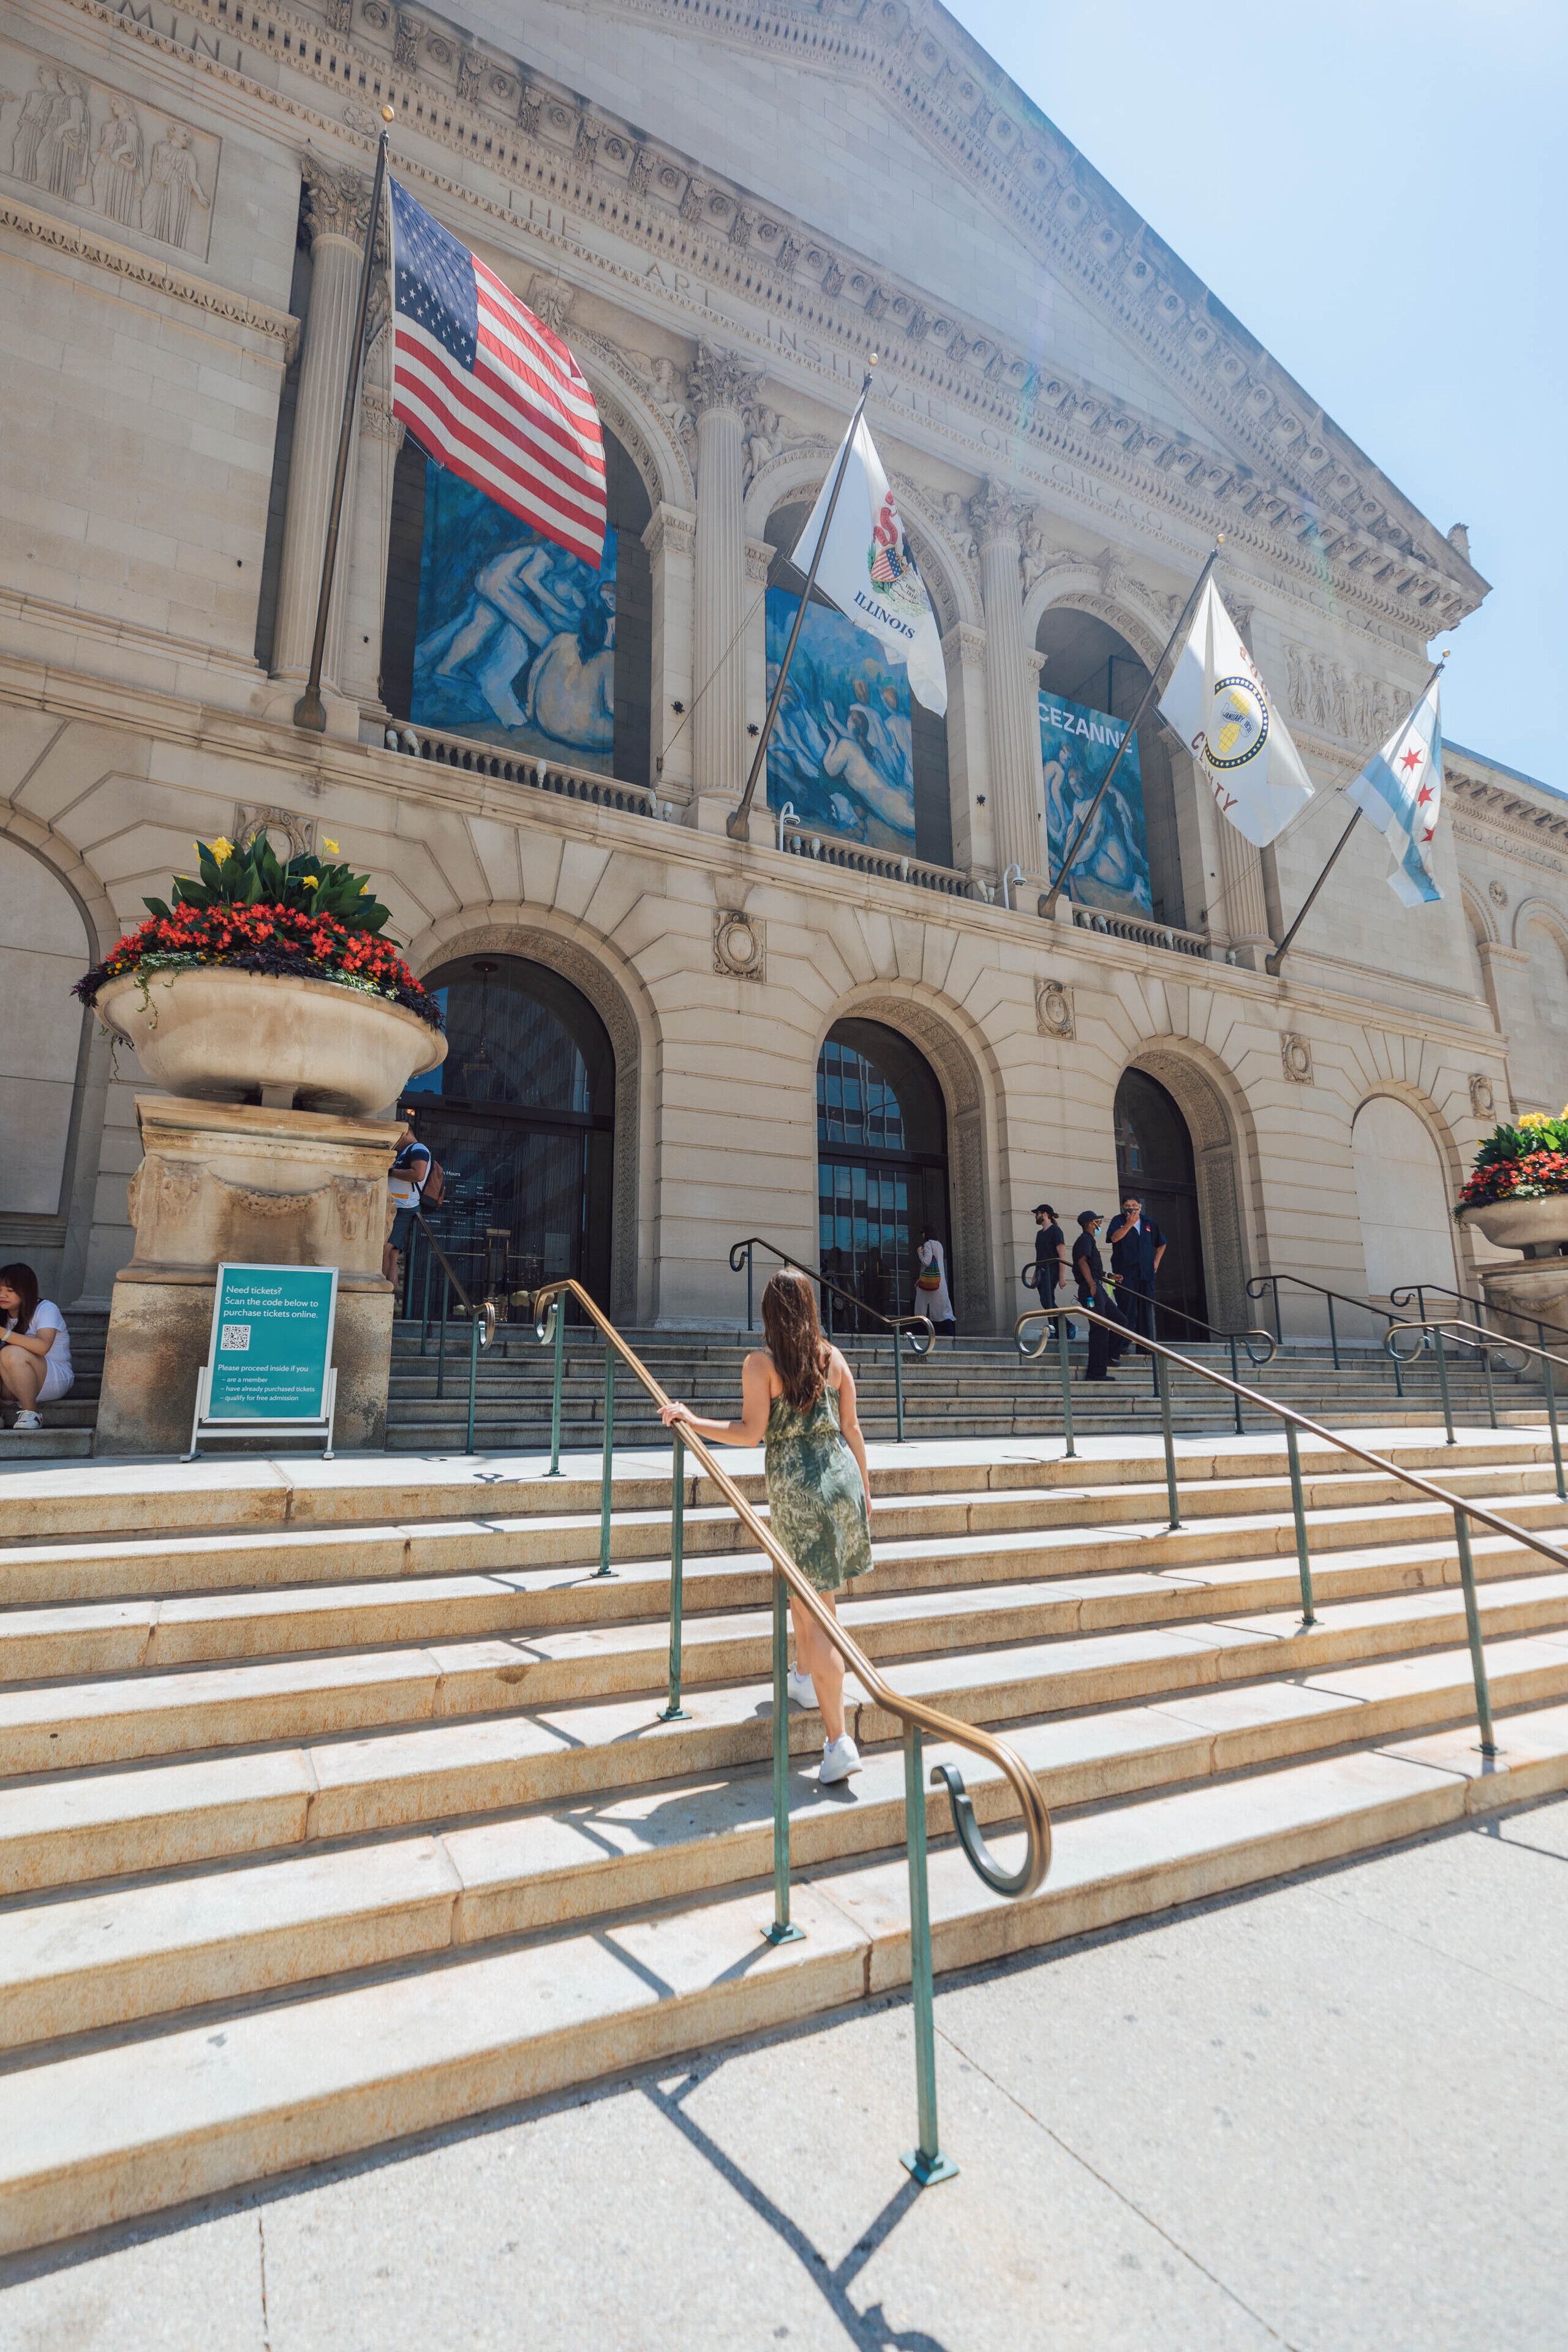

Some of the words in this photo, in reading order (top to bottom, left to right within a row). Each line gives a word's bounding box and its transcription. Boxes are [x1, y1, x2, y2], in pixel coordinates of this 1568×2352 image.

[98, 0, 242, 72] MINI
[499, 183, 582, 244] THE
[646, 262, 718, 308] ART
[981, 428, 1018, 456] OF
[1052, 464, 1163, 530] CHICAGO
[854, 590, 916, 638] ILLINOIS
[1223, 711, 1245, 723] JANUARY
[1243, 720, 1253, 734] 1831
[1191, 731, 1238, 812] CNTY
[224, 1308, 261, 1317] purchase
[226, 1285, 249, 1294] Need
[251, 1286, 282, 1295] tickets?
